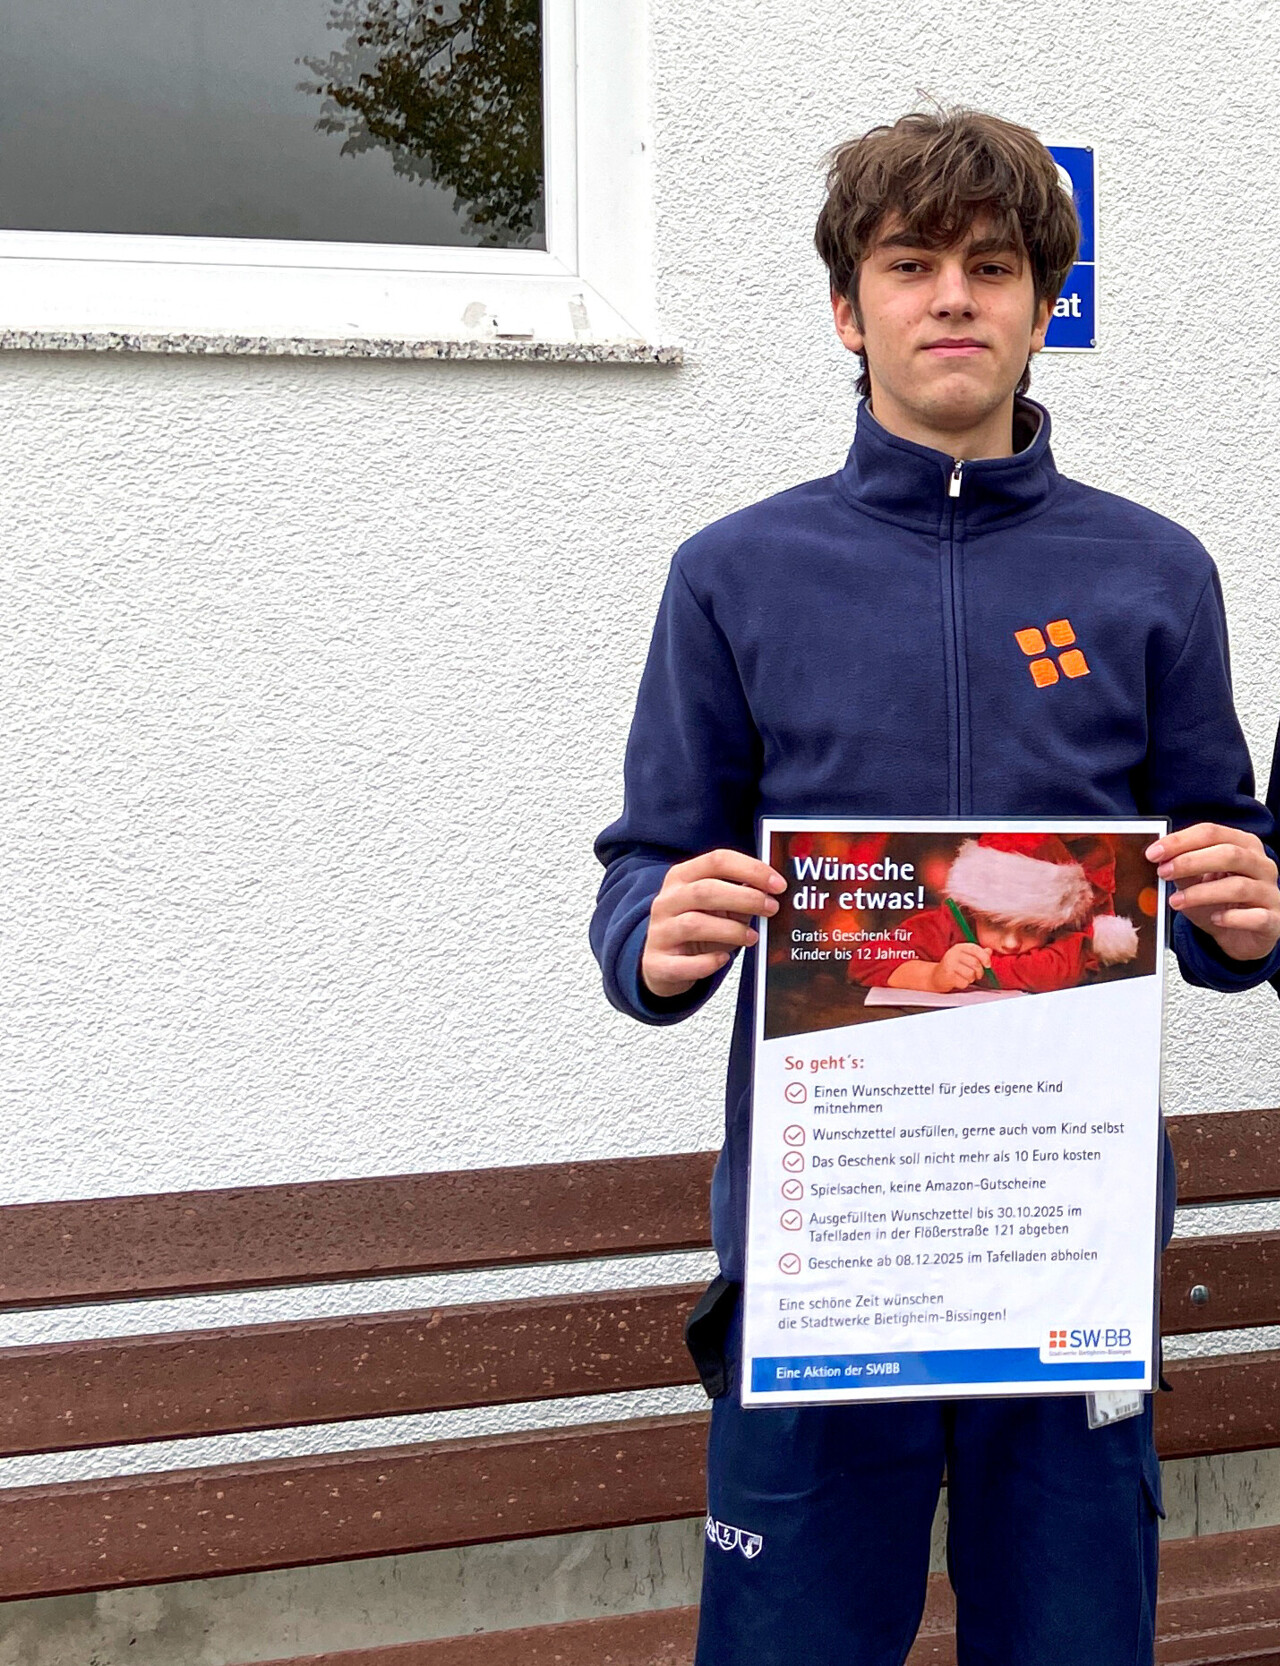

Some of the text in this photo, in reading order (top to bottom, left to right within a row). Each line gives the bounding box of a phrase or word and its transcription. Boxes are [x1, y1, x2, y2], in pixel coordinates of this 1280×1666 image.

[794, 856, 914, 881] Wünsche
[793, 886, 925, 910] dir etwas!
[791, 928, 912, 942] Gratis Geschenk für
[791, 947, 919, 960] Kinder bis 12 Jahren.
[784, 1056, 804, 1070] So
[814, 1081, 1063, 1098] Einen Wunschzettel für jedes eigene Kind
[813, 1102, 883, 1114] mitnehmen
[813, 1122, 1125, 1140] Wunschzettel ausfüllen, gerne auch vom Kind selbst
[812, 1149, 1101, 1168] Das Geschenk soll nicht mehr als 10 Euro kosten
[810, 1177, 1047, 1198] Spielsachen, keine Amazon-Gutscheine
[809, 1205, 1082, 1227] Ausgefüllten Wunschzettel bis 30.10.2025 im
[809, 1223, 1069, 1243] Tafelladen in der Flößerstraße 121 abgeben
[808, 1249, 1098, 1270] Geschenke ab 08.12.2025 im Tafelladen abholen
[779, 1293, 944, 1311] Eine schöne Zeit wünschen
[778, 1309, 1007, 1330] die Stadtwerke Bietigheim-Bissingen!
[776, 1362, 900, 1379] Eine Aktion der SWBB
